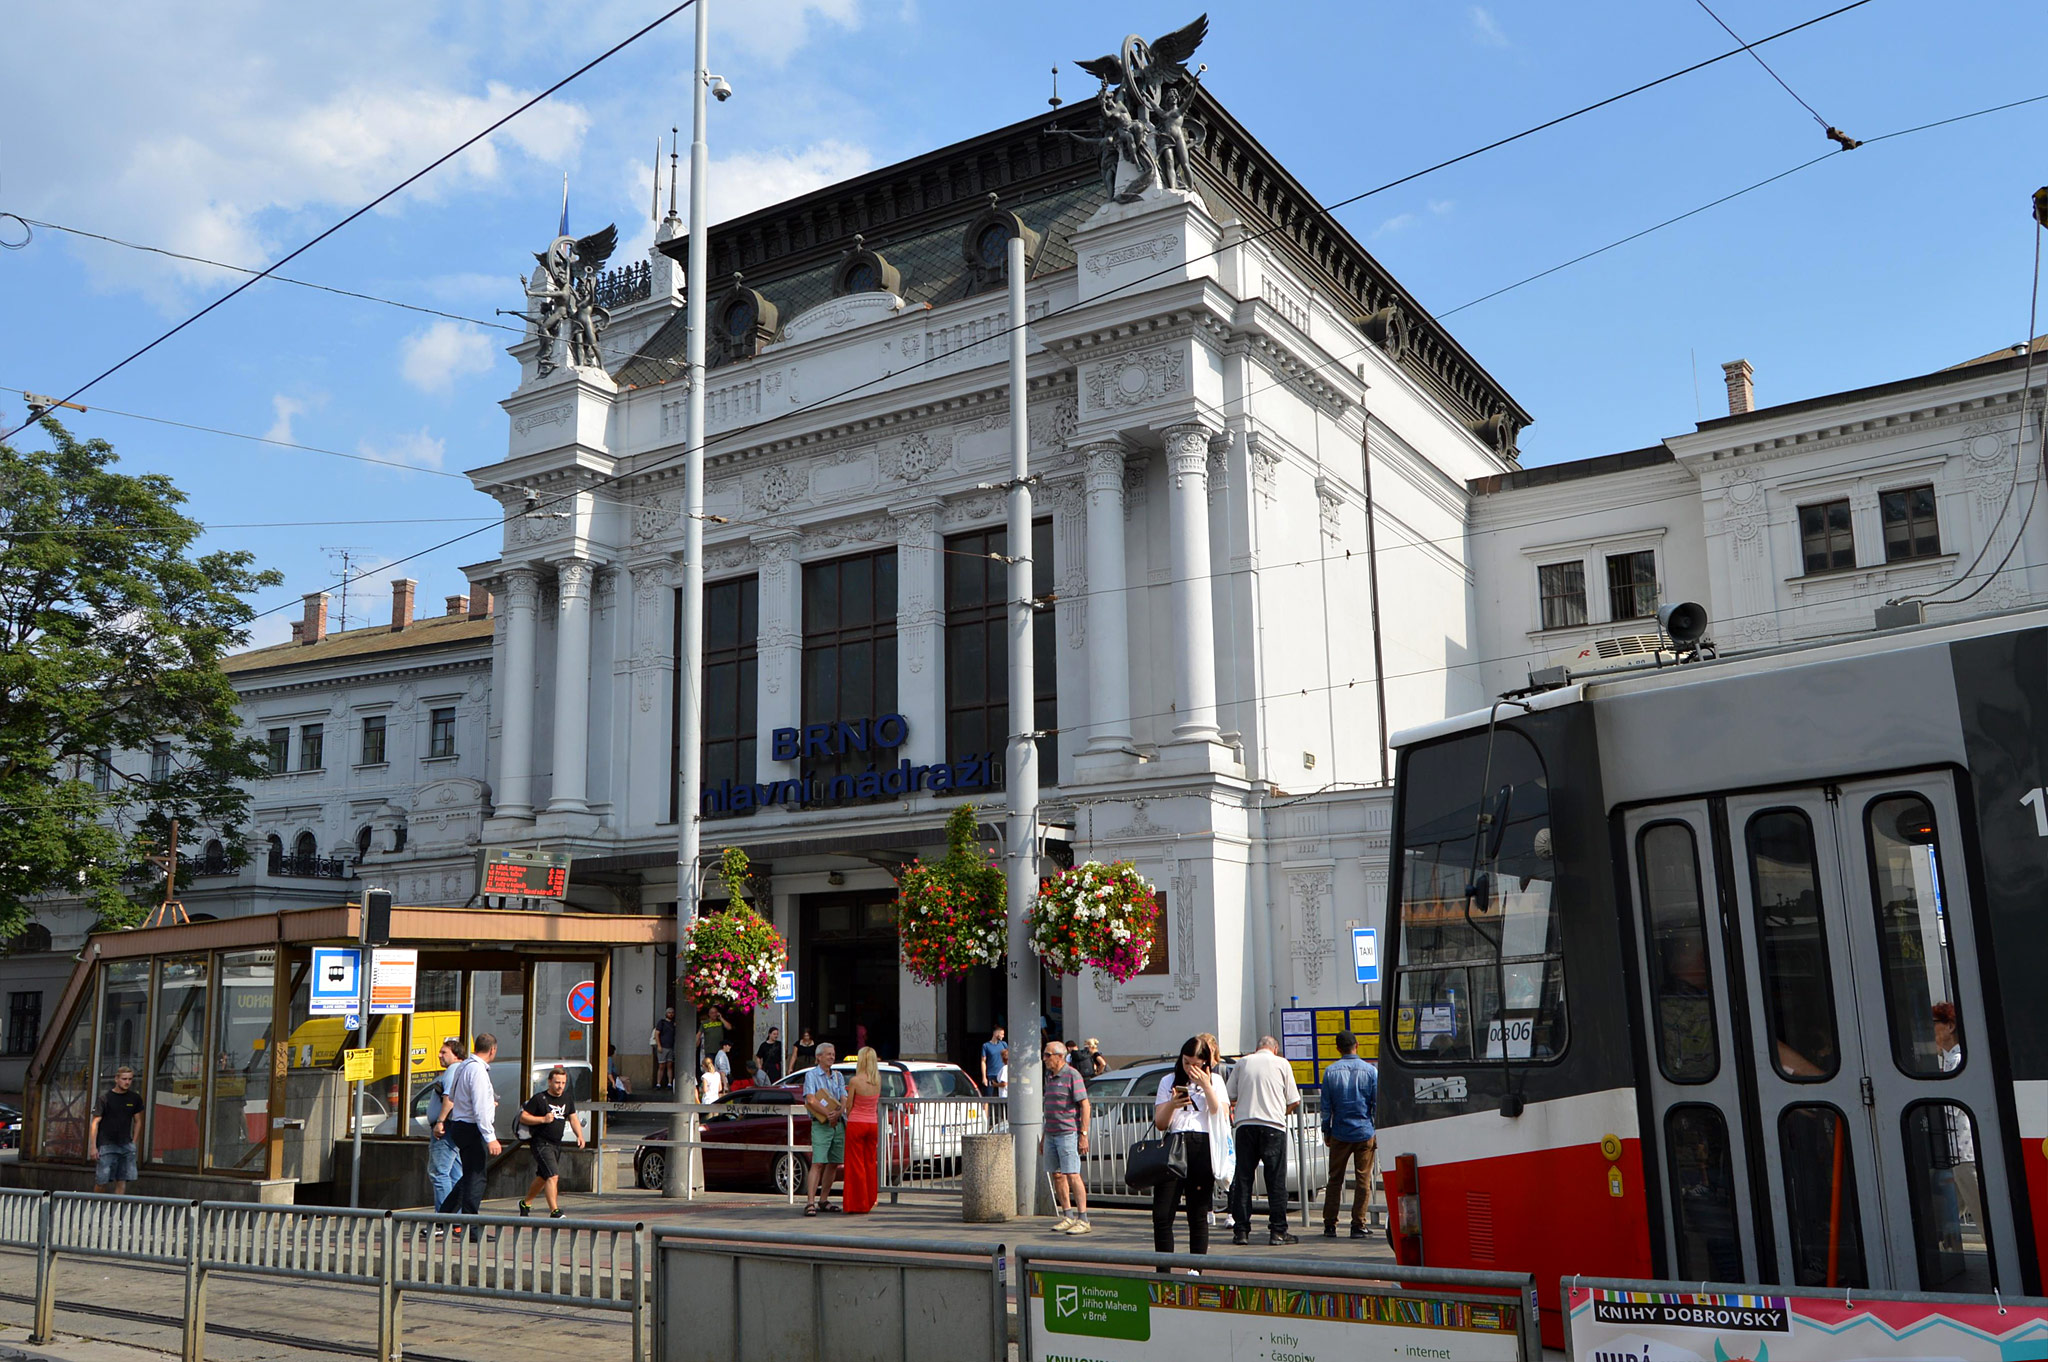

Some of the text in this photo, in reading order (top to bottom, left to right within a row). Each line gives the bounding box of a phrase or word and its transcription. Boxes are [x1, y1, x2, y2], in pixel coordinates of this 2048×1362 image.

[771, 714, 910, 762] BRNO
[829, 752, 996, 801] nádraží
[2019, 787, 2048, 836] 1
[1359, 947, 1373, 956] TAXI
[1082, 1286, 1119, 1298] Knihovna
[1082, 1297, 1138, 1312] Jiřího Mahena
[1089, 1311, 1107, 1322] Brně
[1599, 1305, 1781, 1327] KNIHY DOBROVSKÝ
[1270, 1332, 1299, 1349] knihy
[1405, 1345, 1451, 1359] internet
